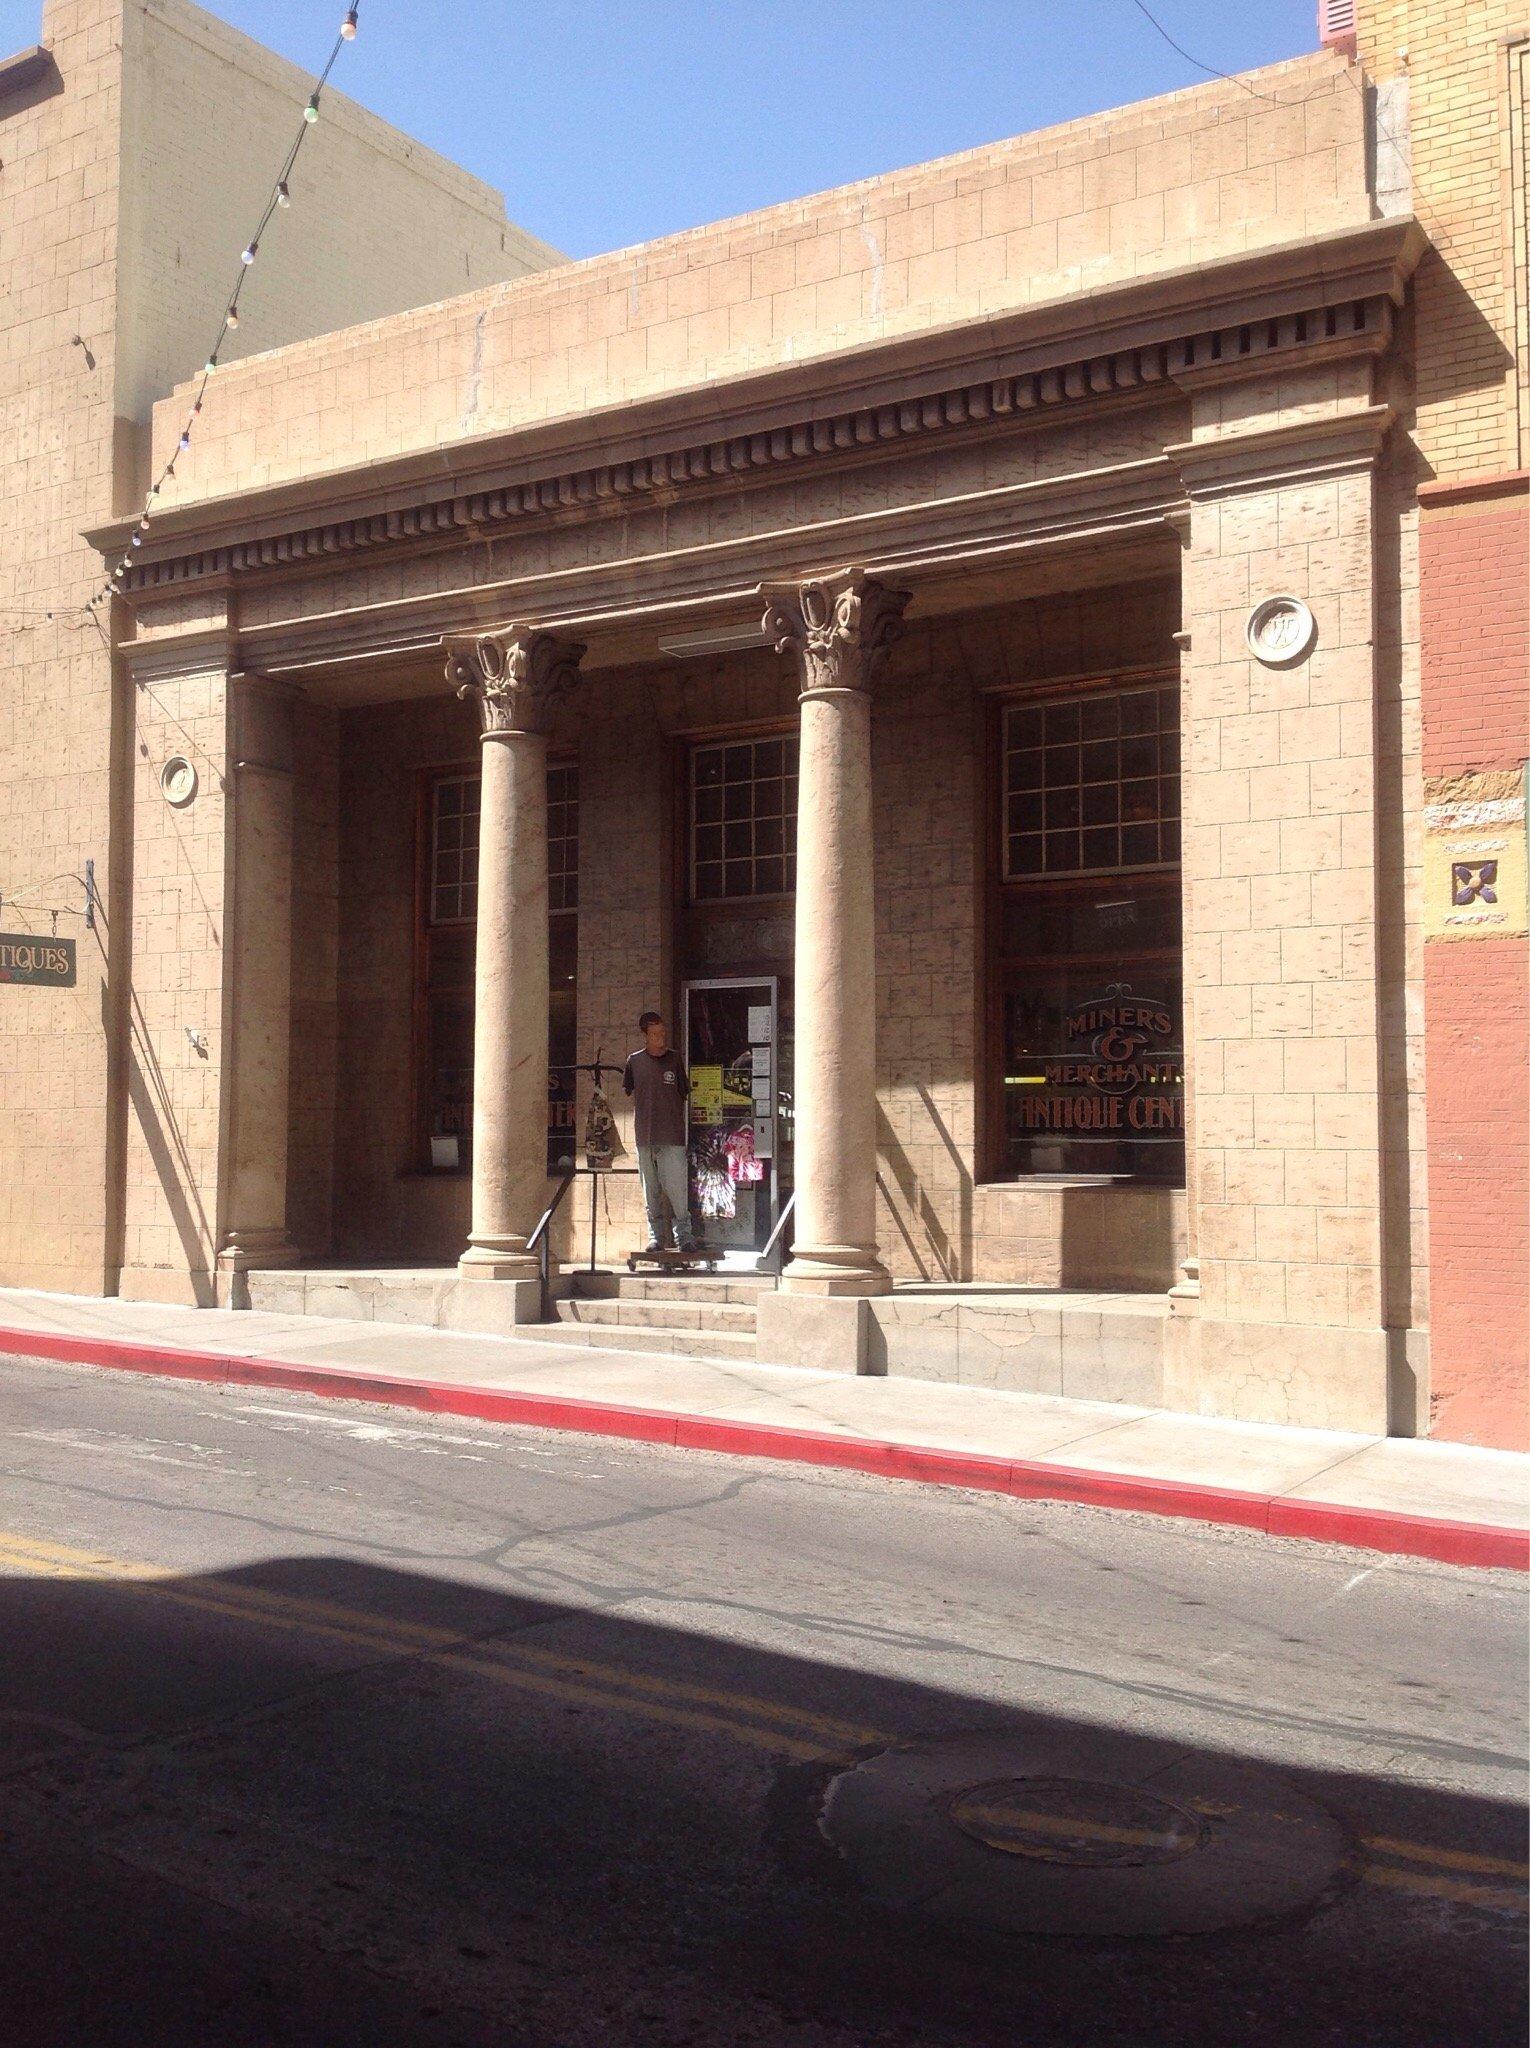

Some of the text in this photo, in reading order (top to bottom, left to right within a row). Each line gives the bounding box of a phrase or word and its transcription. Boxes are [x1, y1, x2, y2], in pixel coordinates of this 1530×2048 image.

[0, 945, 69, 974] TIQUES
[1066, 1008, 1172, 1040] MINERS
[1101, 1027, 1148, 1061] &
[1018, 1096, 1123, 1129] ANTIQUE
